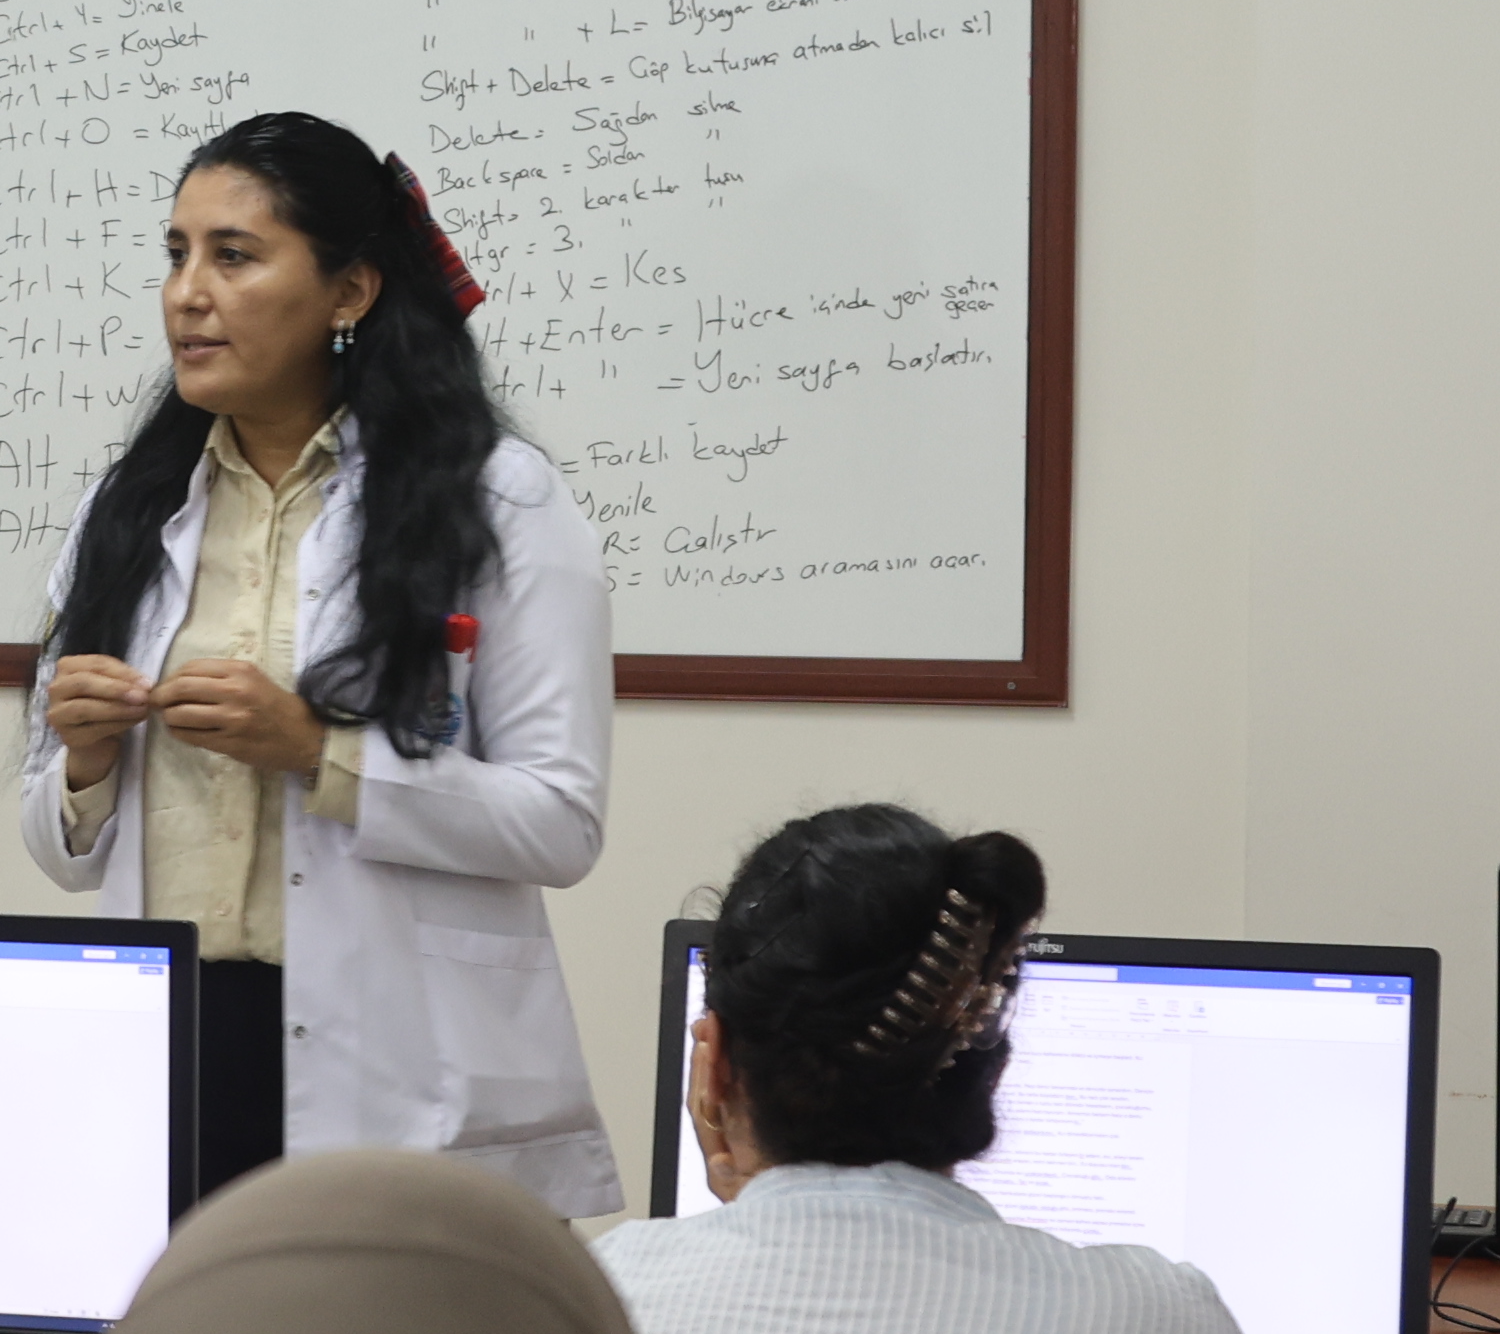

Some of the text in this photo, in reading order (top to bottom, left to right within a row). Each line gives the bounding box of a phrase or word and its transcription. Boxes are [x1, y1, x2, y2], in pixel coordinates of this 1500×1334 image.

[119, 21, 209, 67] Kaydet
[507, 59, 592, 97] Delete
[463, 239, 510, 273] ltgr
[624, 249, 688, 288] Kes
[697, 293, 795, 343] Hücre
[694, 348, 761, 394] Yeni
[776, 358, 861, 392] sayfa
[664, 563, 785, 588] Windows
